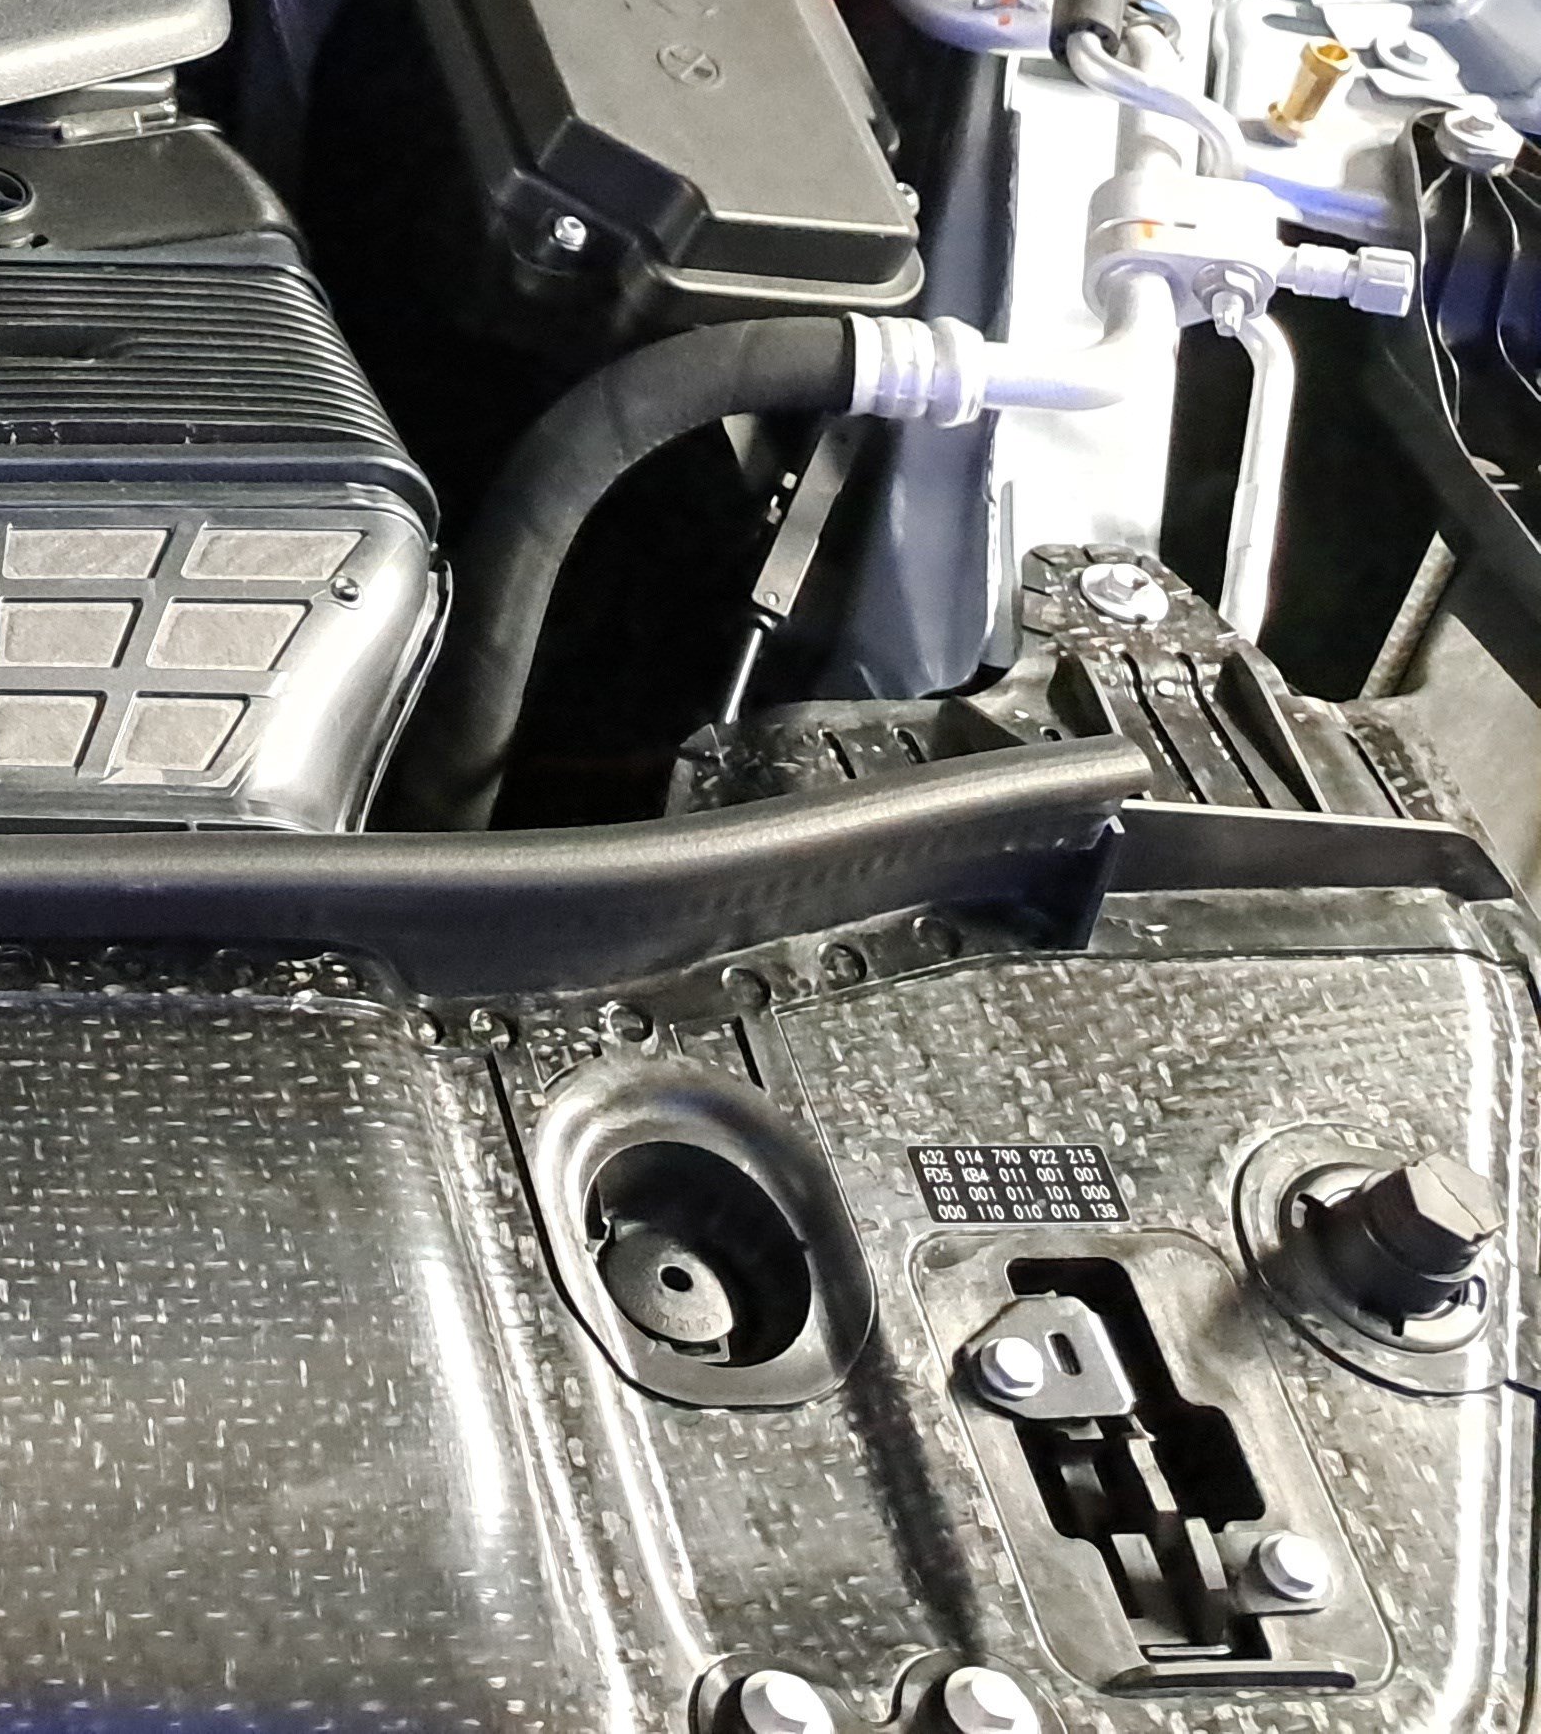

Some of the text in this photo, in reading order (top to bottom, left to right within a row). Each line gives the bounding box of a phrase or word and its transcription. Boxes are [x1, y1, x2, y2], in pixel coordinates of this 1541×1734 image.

[918, 1149, 1096, 1166] 632 014 790 922 215
[923, 1167, 953, 1184] FD5
[998, 1167, 1028, 1184] 011
[1035, 1167, 1065, 1184] 001
[1073, 1167, 1103, 1184] 001
[932, 1185, 1112, 1202] 101 001 011 101 000
[937, 1203, 1120, 1221] 000 110 010 010 138
